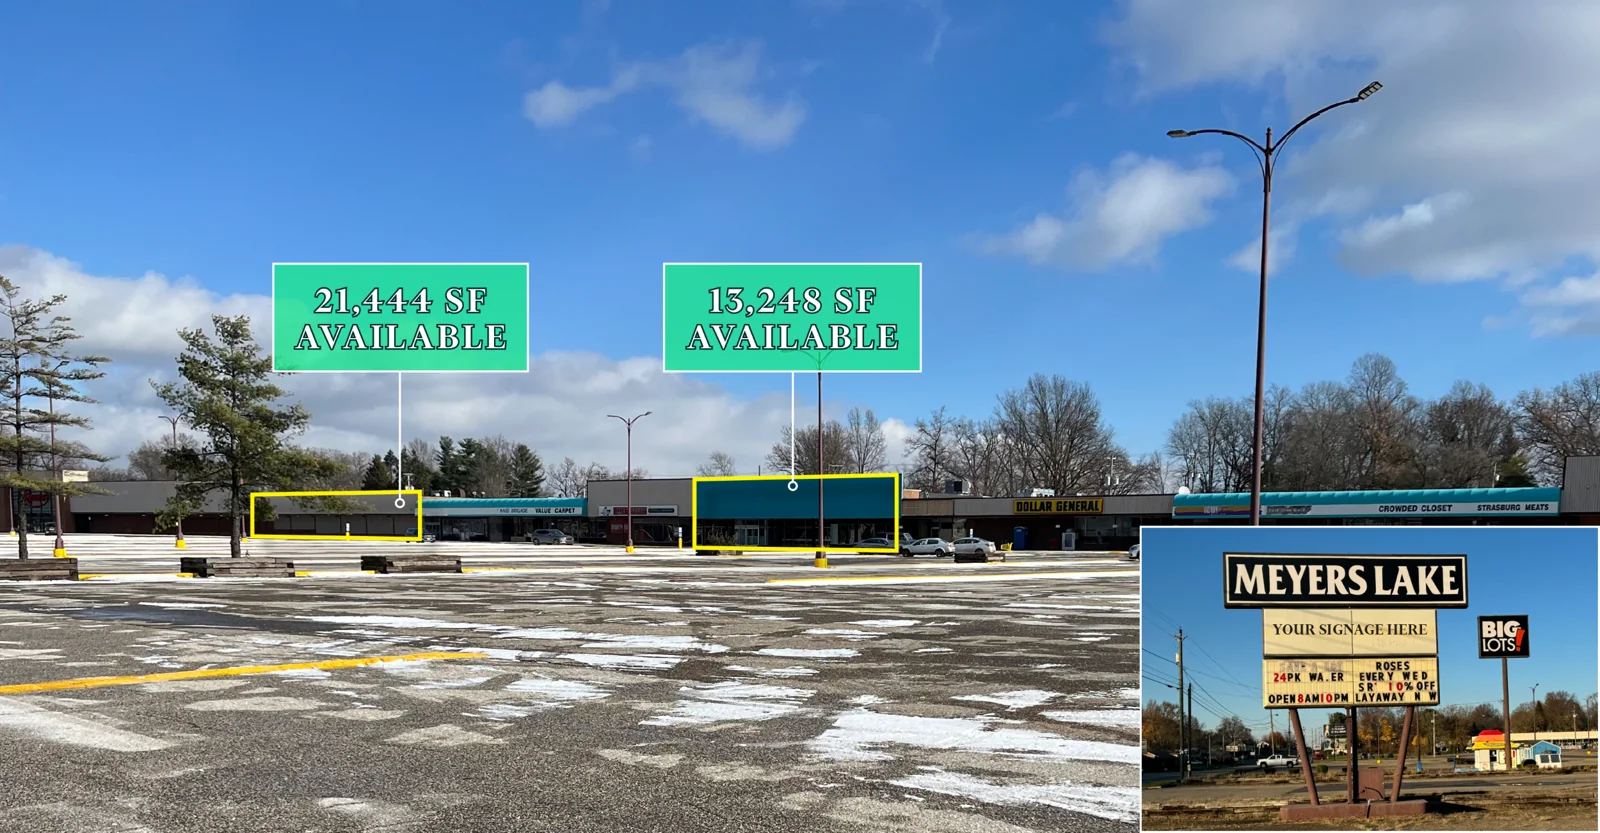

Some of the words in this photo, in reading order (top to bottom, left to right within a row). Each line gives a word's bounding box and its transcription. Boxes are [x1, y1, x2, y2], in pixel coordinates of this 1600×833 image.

[1017, 500, 1053, 512] DOLLAR
[1056, 500, 1100, 512] GENERAL
[1378, 504, 1418, 513] CROWDED
[1421, 503, 1452, 512] CLOSET
[1477, 503, 1521, 512] STRASBURG
[1525, 503, 1549, 511] MEATS
[1234, 563, 1368, 596] MEYERS
[1374, 564, 1460, 596] LAKE
[1273, 623, 1315, 635] YOUR
[1319, 623, 1383, 635] SIGNAGE
[1387, 623, 1428, 635] HERE
[1482, 620, 1522, 638] BIG
[1376, 661, 1410, 670] ROSES
[1273, 673, 1301, 682] 24PK
[1359, 671, 1394, 681] EVERY
[1416, 681, 1436, 690] OFF
[1355, 692, 1405, 702] LAYAWAY
